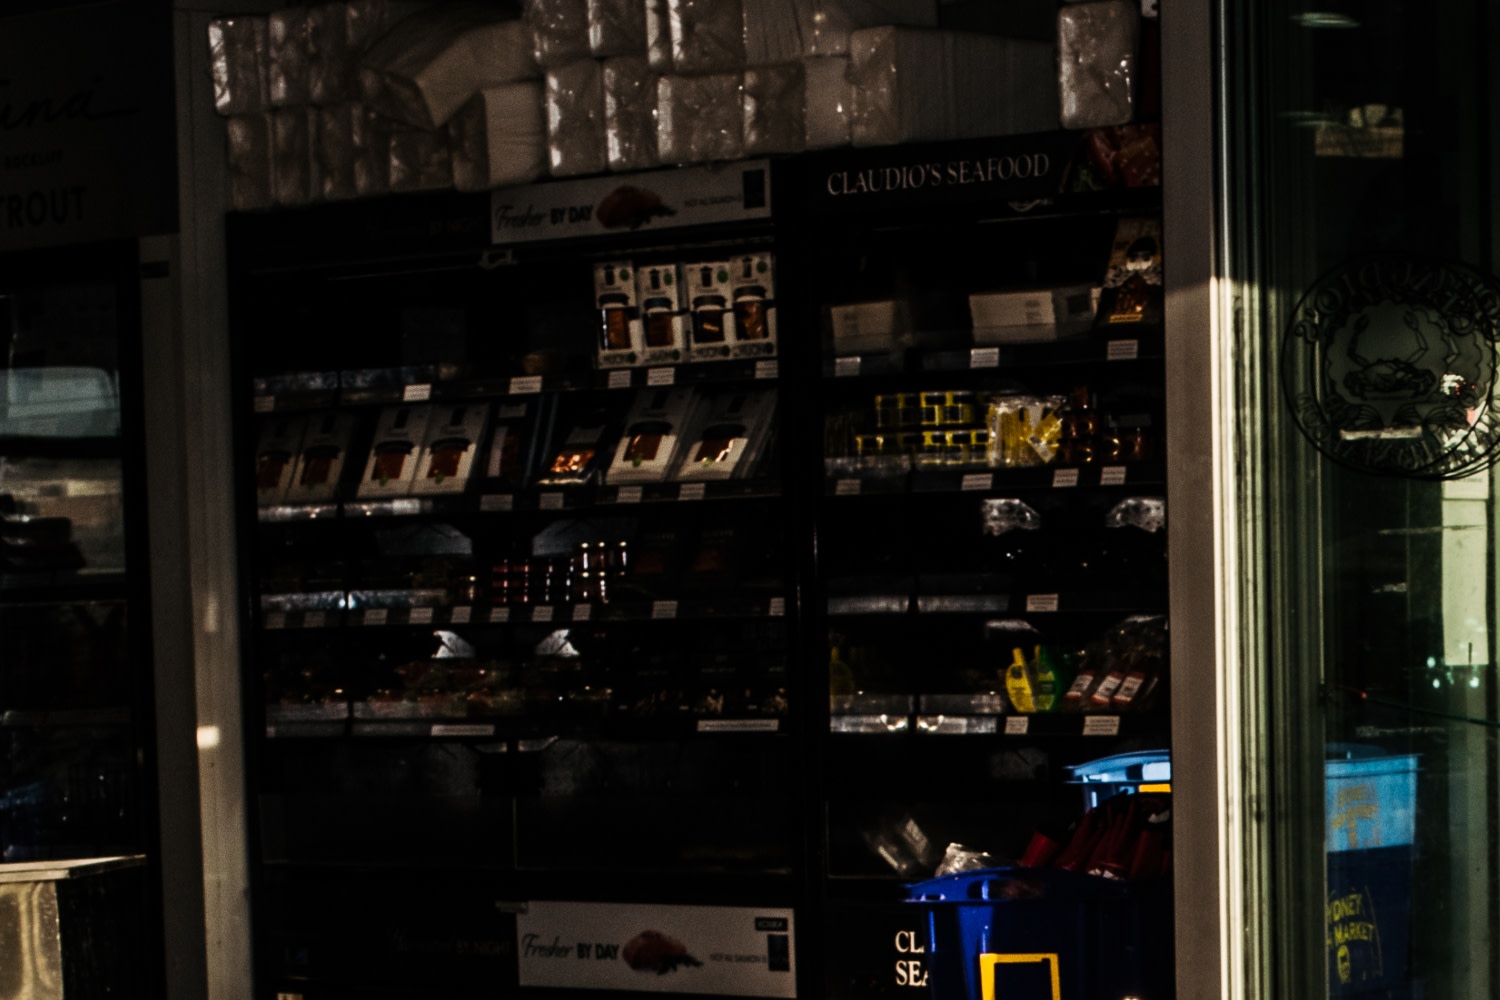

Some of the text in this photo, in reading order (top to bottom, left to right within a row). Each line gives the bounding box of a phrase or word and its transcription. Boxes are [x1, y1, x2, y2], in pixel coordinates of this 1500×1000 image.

[826, 152, 1051, 196] CLAUDIO'S SEAFOOD
[0, 185, 86, 228] ROUT
[550, 207, 566, 225] BY
[569, 204, 594, 223] DAY
[521, 932, 574, 959] Fresher
[577, 943, 592, 959] BY
[595, 943, 620, 959] DAY
